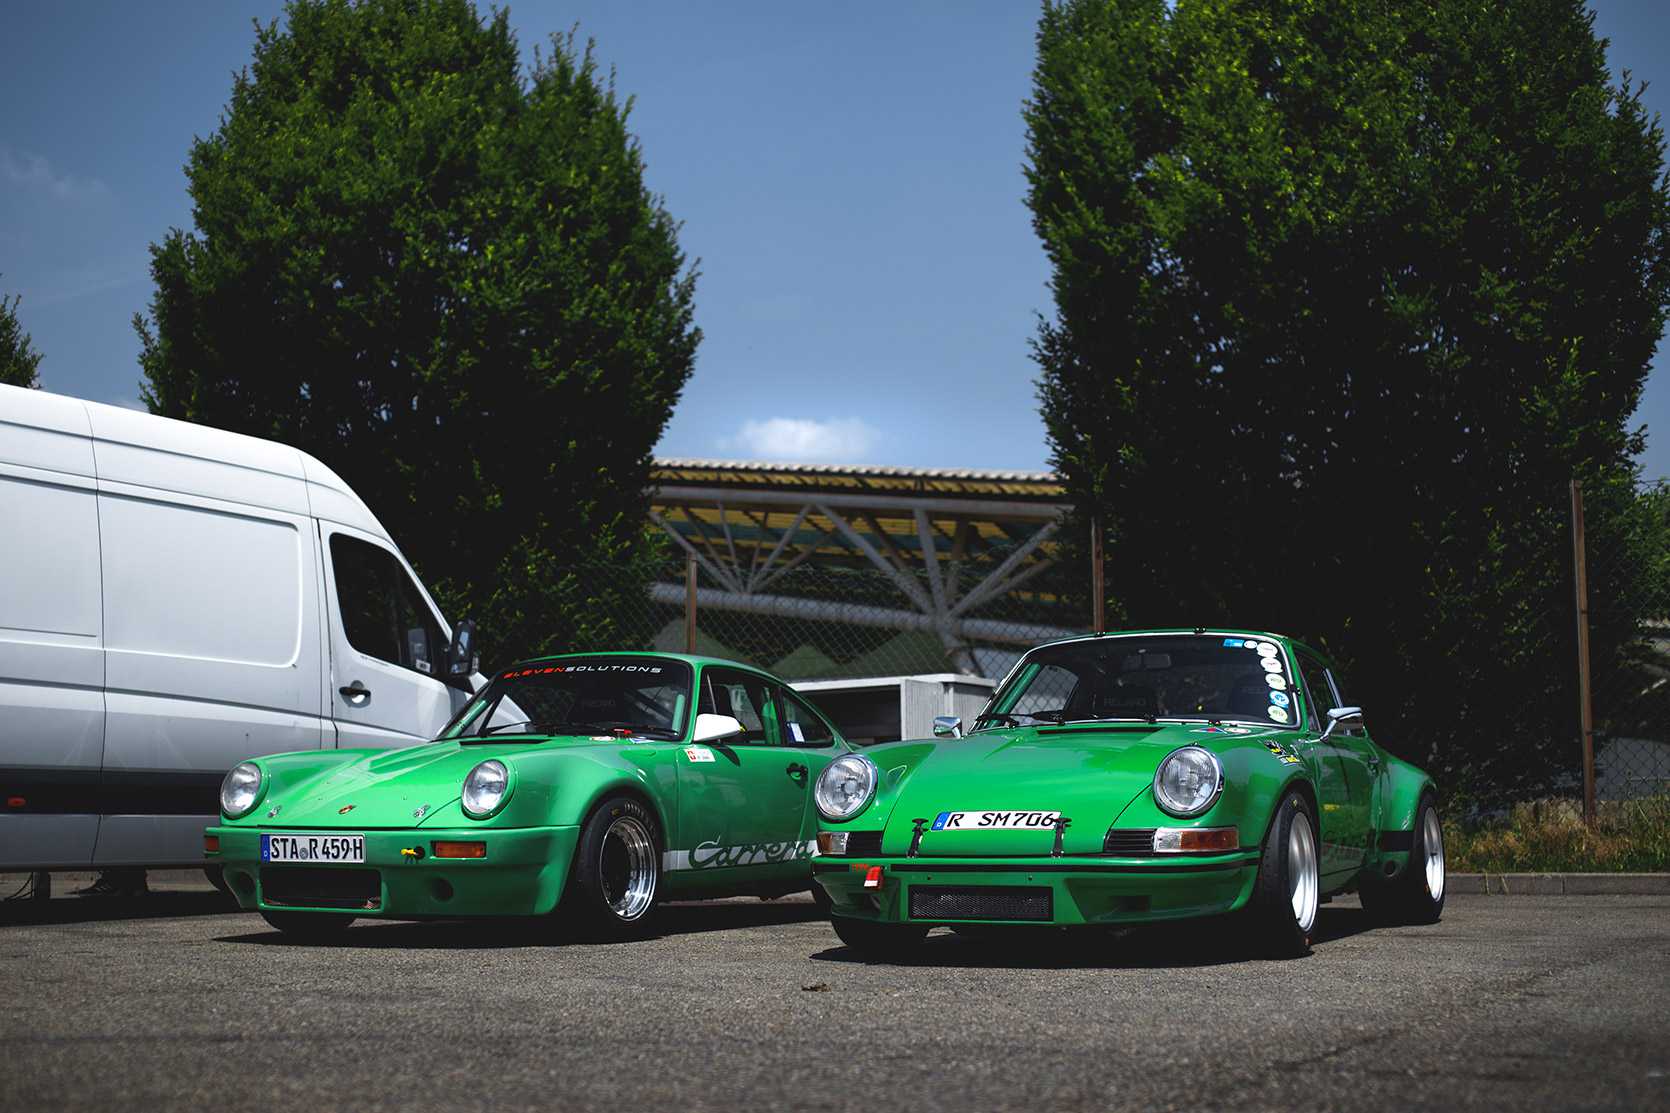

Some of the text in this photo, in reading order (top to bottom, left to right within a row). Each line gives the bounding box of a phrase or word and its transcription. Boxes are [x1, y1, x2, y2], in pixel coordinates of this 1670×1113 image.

[946, 813, 965, 827] R
[271, 838, 299, 859] STA
[687, 835, 816, 869] Carrera
[851, 862, 870, 872] TOW
